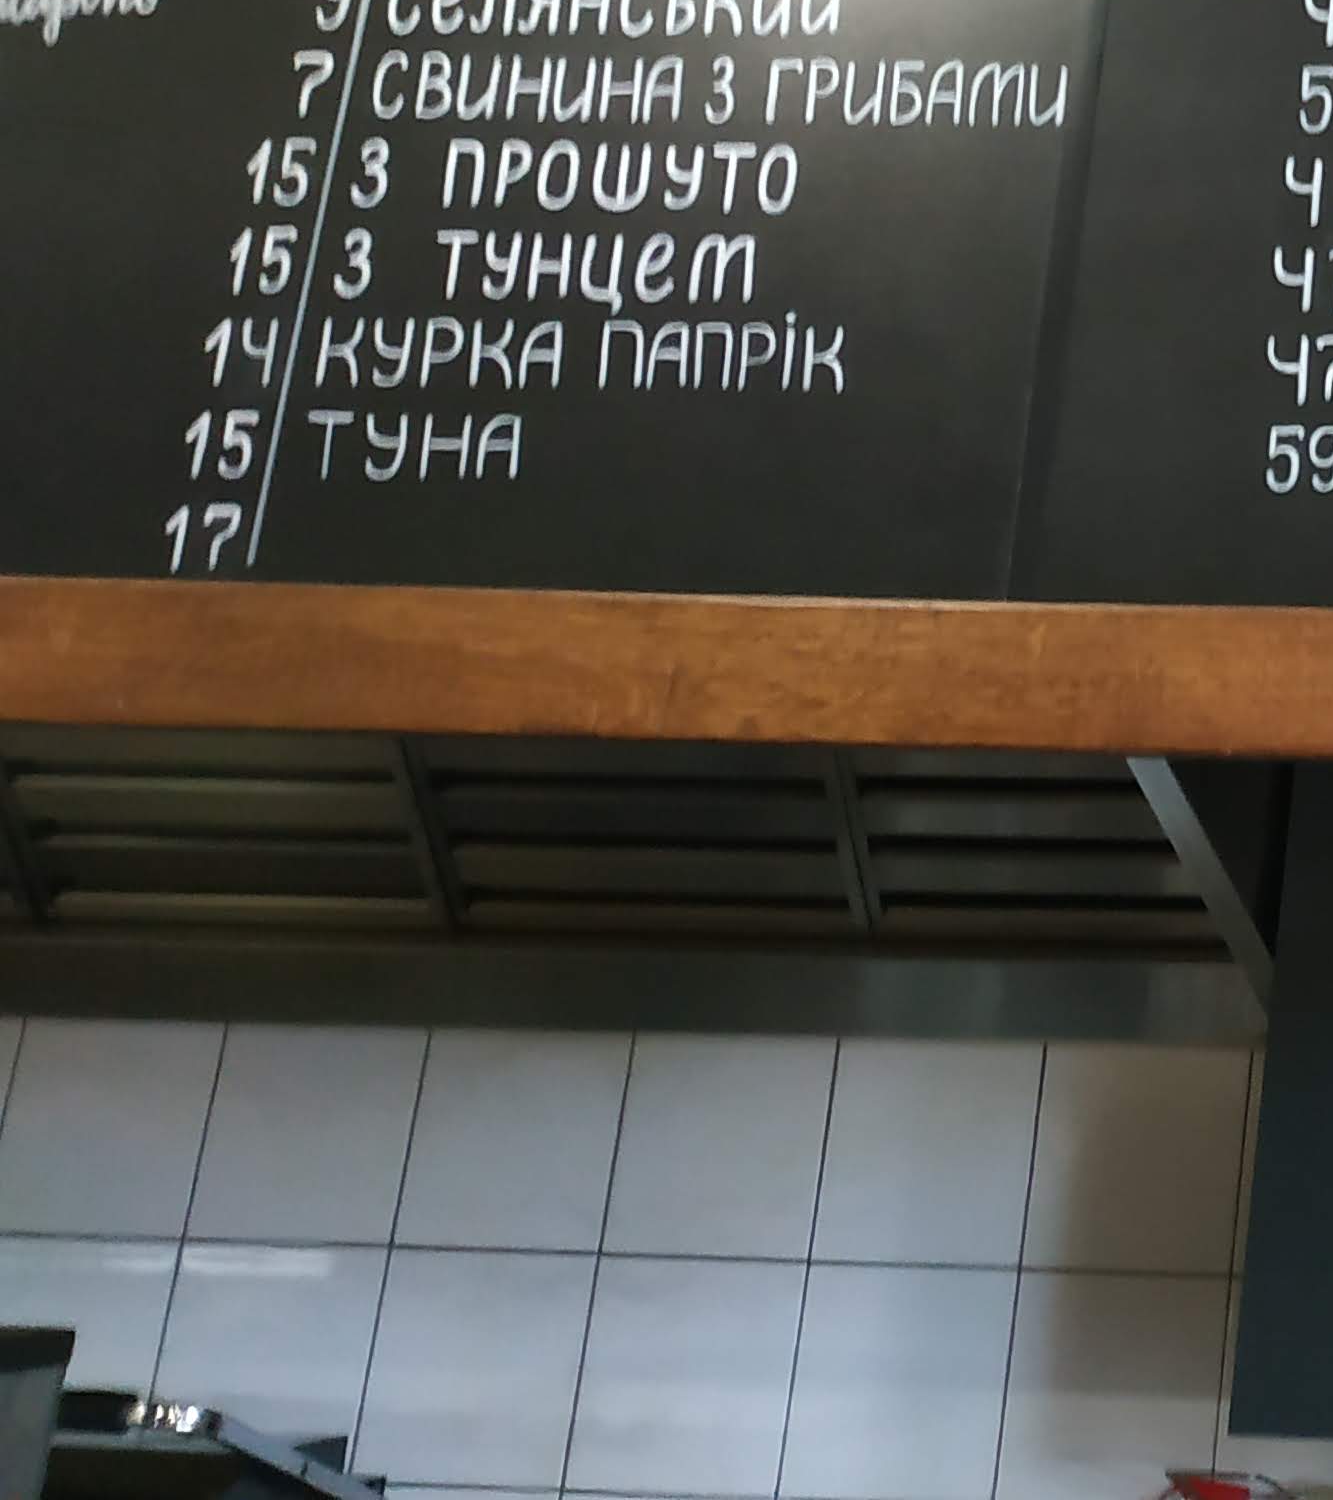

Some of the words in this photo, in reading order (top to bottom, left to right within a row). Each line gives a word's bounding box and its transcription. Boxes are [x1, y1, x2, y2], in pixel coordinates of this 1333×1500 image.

[293, 49, 334, 120] 7
[372, 49, 684, 124] СВИНИНА
[764, 57, 1070, 128] ГРИБАМИ
[246, 136, 313, 208] 15
[441, 141, 801, 217] ПРОШУТО
[228, 226, 296, 298] 15
[436, 229, 758, 315] ТУНЦЕМ
[203, 316, 280, 391] 14
[315, 315, 565, 390] КУРКА
[597, 309, 846, 394] ПАПРІК
[184, 408, 261, 482] 15
[307, 409, 523, 483] ТУНА
[163, 503, 243, 575] 17
